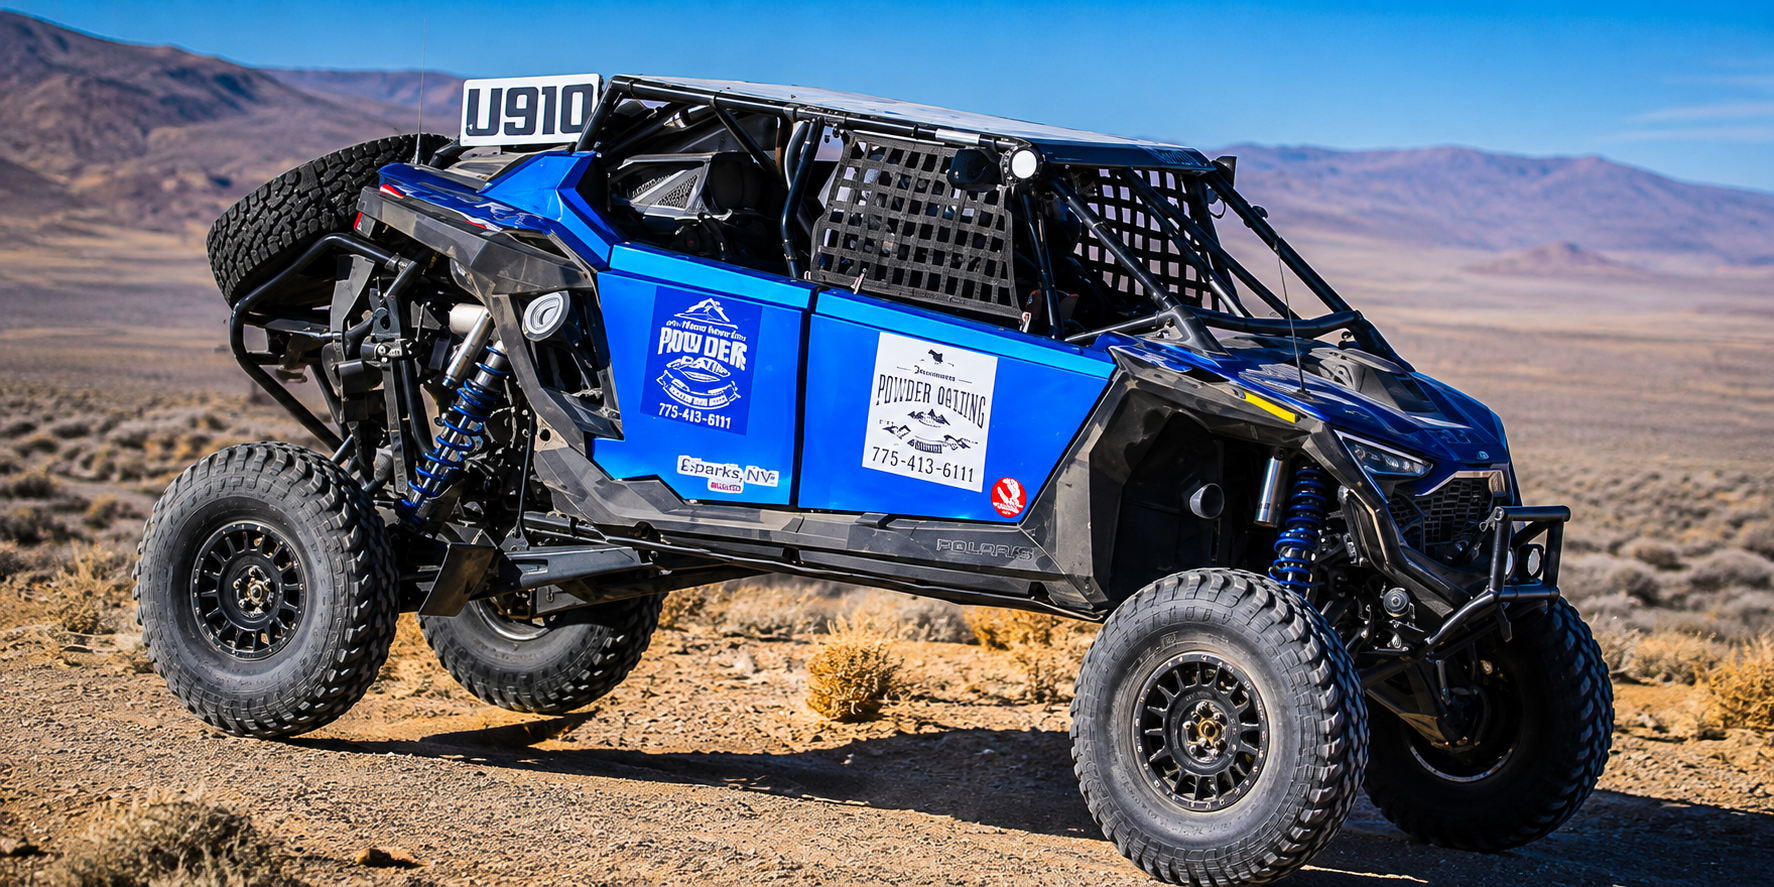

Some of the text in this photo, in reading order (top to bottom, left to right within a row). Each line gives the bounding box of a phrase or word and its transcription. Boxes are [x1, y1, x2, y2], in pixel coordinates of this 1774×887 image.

[466, 83, 594, 136] U910
[876, 374, 932, 406] POWDER
[659, 402, 731, 429] 775-413-6111
[872, 446, 974, 483] 775-413-6111
